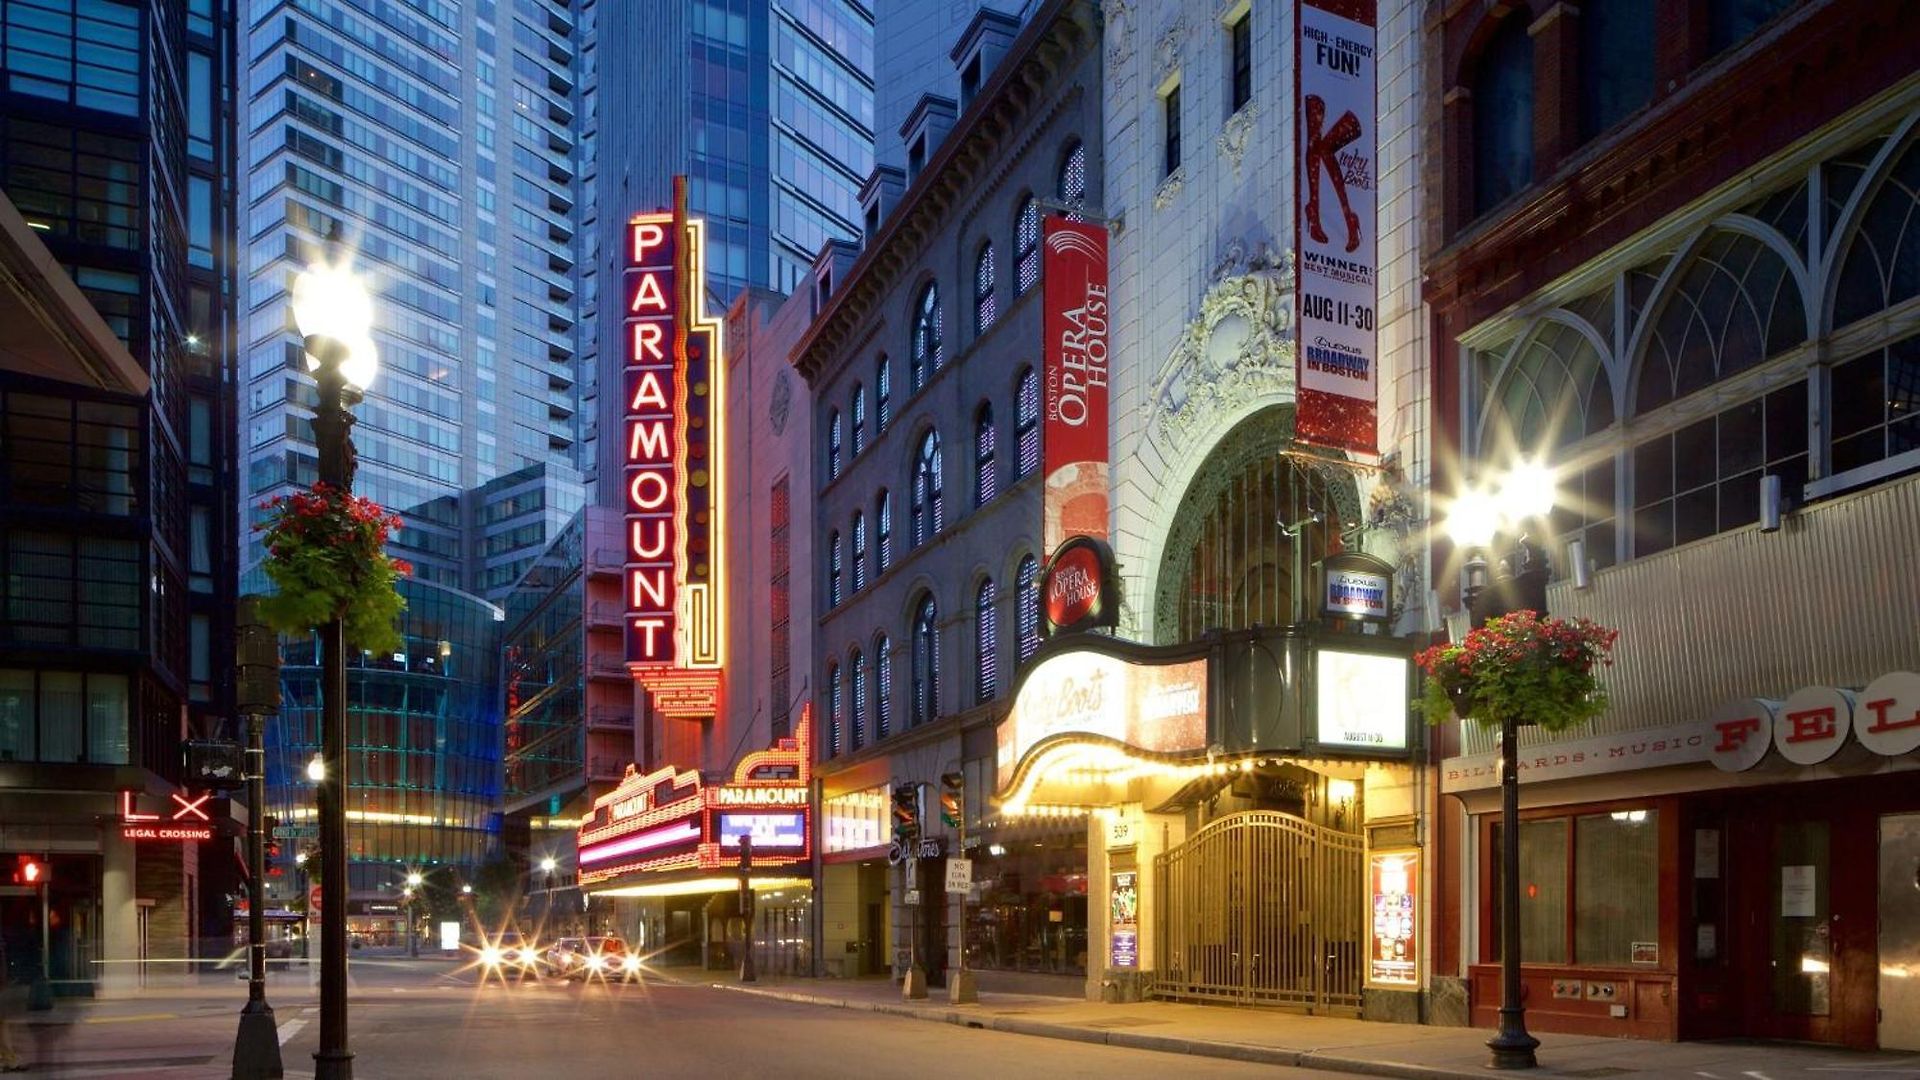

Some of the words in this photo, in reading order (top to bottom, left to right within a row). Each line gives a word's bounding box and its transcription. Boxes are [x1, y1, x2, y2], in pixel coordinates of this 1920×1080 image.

[1316, 42, 1360, 77] FUN!
[1304, 250, 1373, 277] WINNER!
[1304, 262, 1329, 277] BEST
[1331, 268, 1373, 286] MUSICAL
[1303, 293, 1333, 322] AUG
[1337, 300, 1373, 332] 11-30
[1087, 283, 1107, 388] HOUSE
[1058, 304, 1088, 427] OPERA
[1307, 346, 1370, 372] BROADWAY
[1307, 359, 1320, 371] IN
[1322, 363, 1369, 381] BOSTON
[1049, 365, 1059, 422] BOSTON
[629, 223, 670, 658] PARAMOUNT
[1055, 568, 1089, 597] OPERA
[1066, 578, 1097, 607] HOUSE
[1330, 583, 1384, 600] BROADWAY
[1447, 752, 1586, 781] BILLARDS
[1608, 735, 1703, 758] MUSIC
[719, 787, 809, 805] PARAMOUNT
[125, 829, 157, 838] LEGAL
[160, 830, 211, 840] CROSSING
[954, 862, 965, 870] NO
